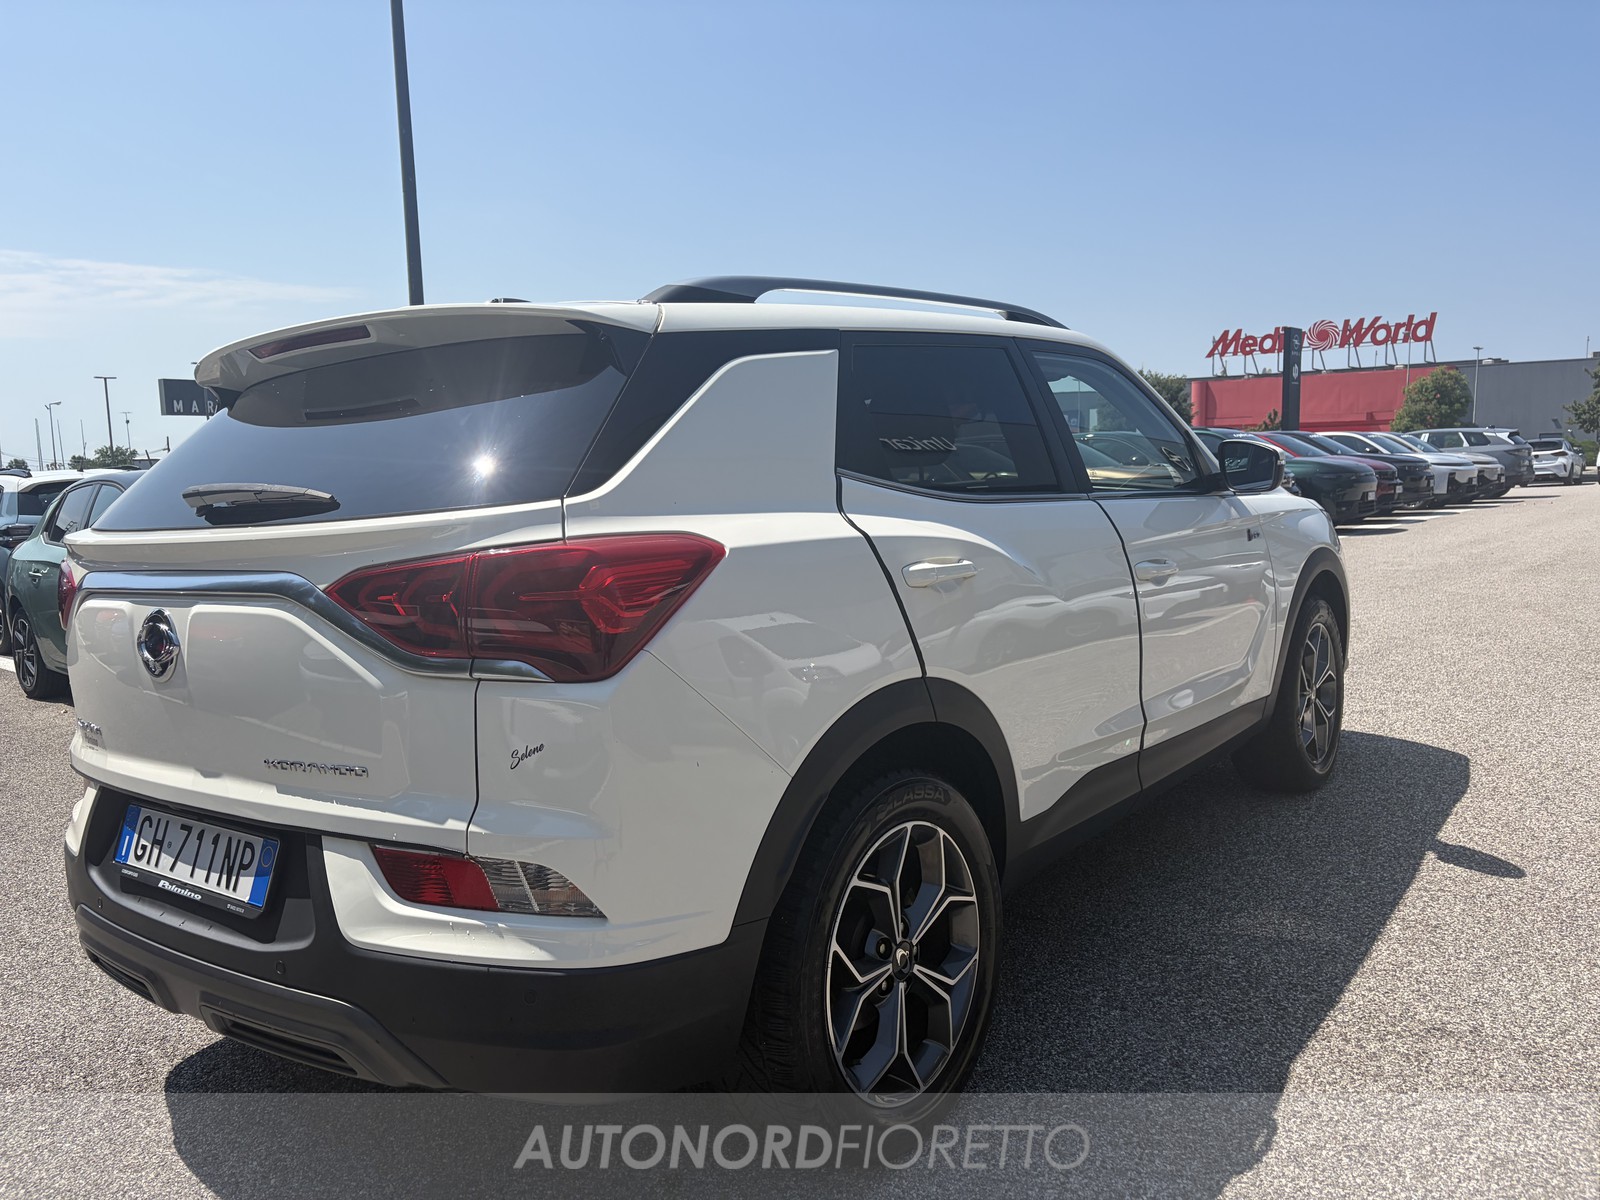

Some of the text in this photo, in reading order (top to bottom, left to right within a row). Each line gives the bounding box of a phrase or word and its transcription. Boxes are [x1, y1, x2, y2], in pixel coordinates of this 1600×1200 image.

[1205, 312, 1438, 358] Medi World
[263, 759, 369, 778] KORANDO
[510, 743, 545, 770] Selene
